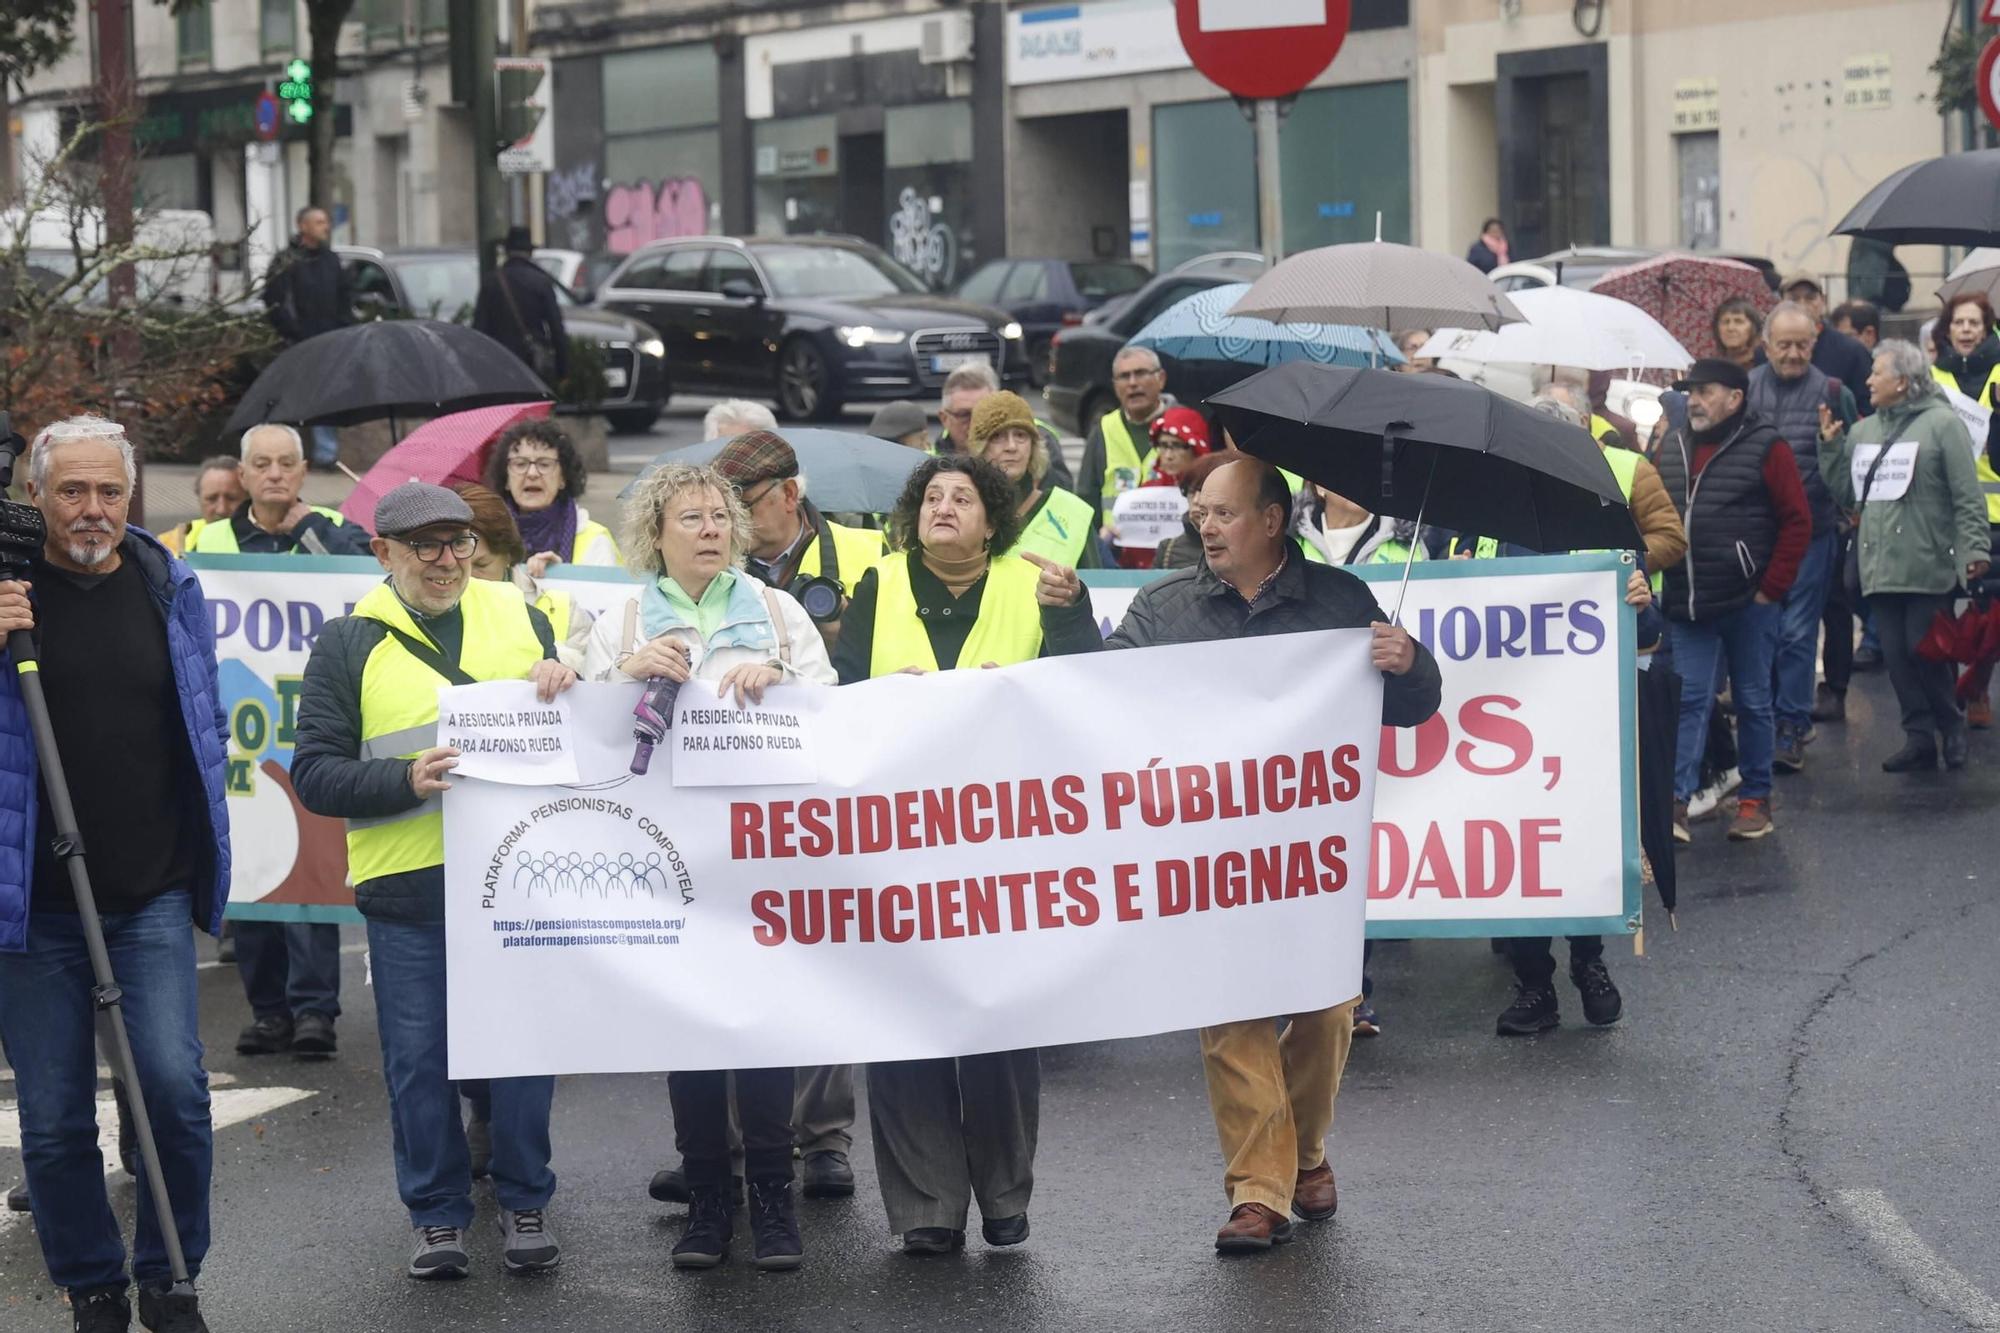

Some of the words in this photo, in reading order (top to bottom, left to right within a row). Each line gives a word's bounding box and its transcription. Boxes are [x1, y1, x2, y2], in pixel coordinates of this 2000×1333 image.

[206, 599, 325, 652] POR
[1396, 602, 1606, 661] IORES
[448, 713, 456, 727] A
[459, 712, 516, 727] RESIDENCIA
[517, 710, 562, 727] PRIVADA
[681, 710, 688, 725] A
[691, 709, 753, 725] RESIDENCIA
[755, 712, 800, 728] PRIVADA
[449, 738, 476, 752] PARA
[479, 738, 527, 752] ALFONSO
[528, 737, 562, 752] RUEDA
[683, 736, 710, 751] PARA
[713, 735, 764, 750] ALFONSO
[766, 735, 802, 750] RUEDA
[731, 775, 1088, 860] RESIDENCIAS
[1102, 744, 1361, 830] PÚBLICAS
[482, 821, 531, 909] PLATAFORMA
[531, 797, 633, 823] PENSIONISTAS
[637, 816, 695, 906] COMPOSTELA
[1367, 818, 1563, 900] DADE
[751, 867, 1100, 946] SUFICIENTES
[1114, 863, 1143, 922] E
[1156, 835, 1348, 917] DIGNAS
[493, 917, 686, 931] https://pensionistascompostela.org/
[503, 932, 680, 948] plataformapensionsc@gmail.com
